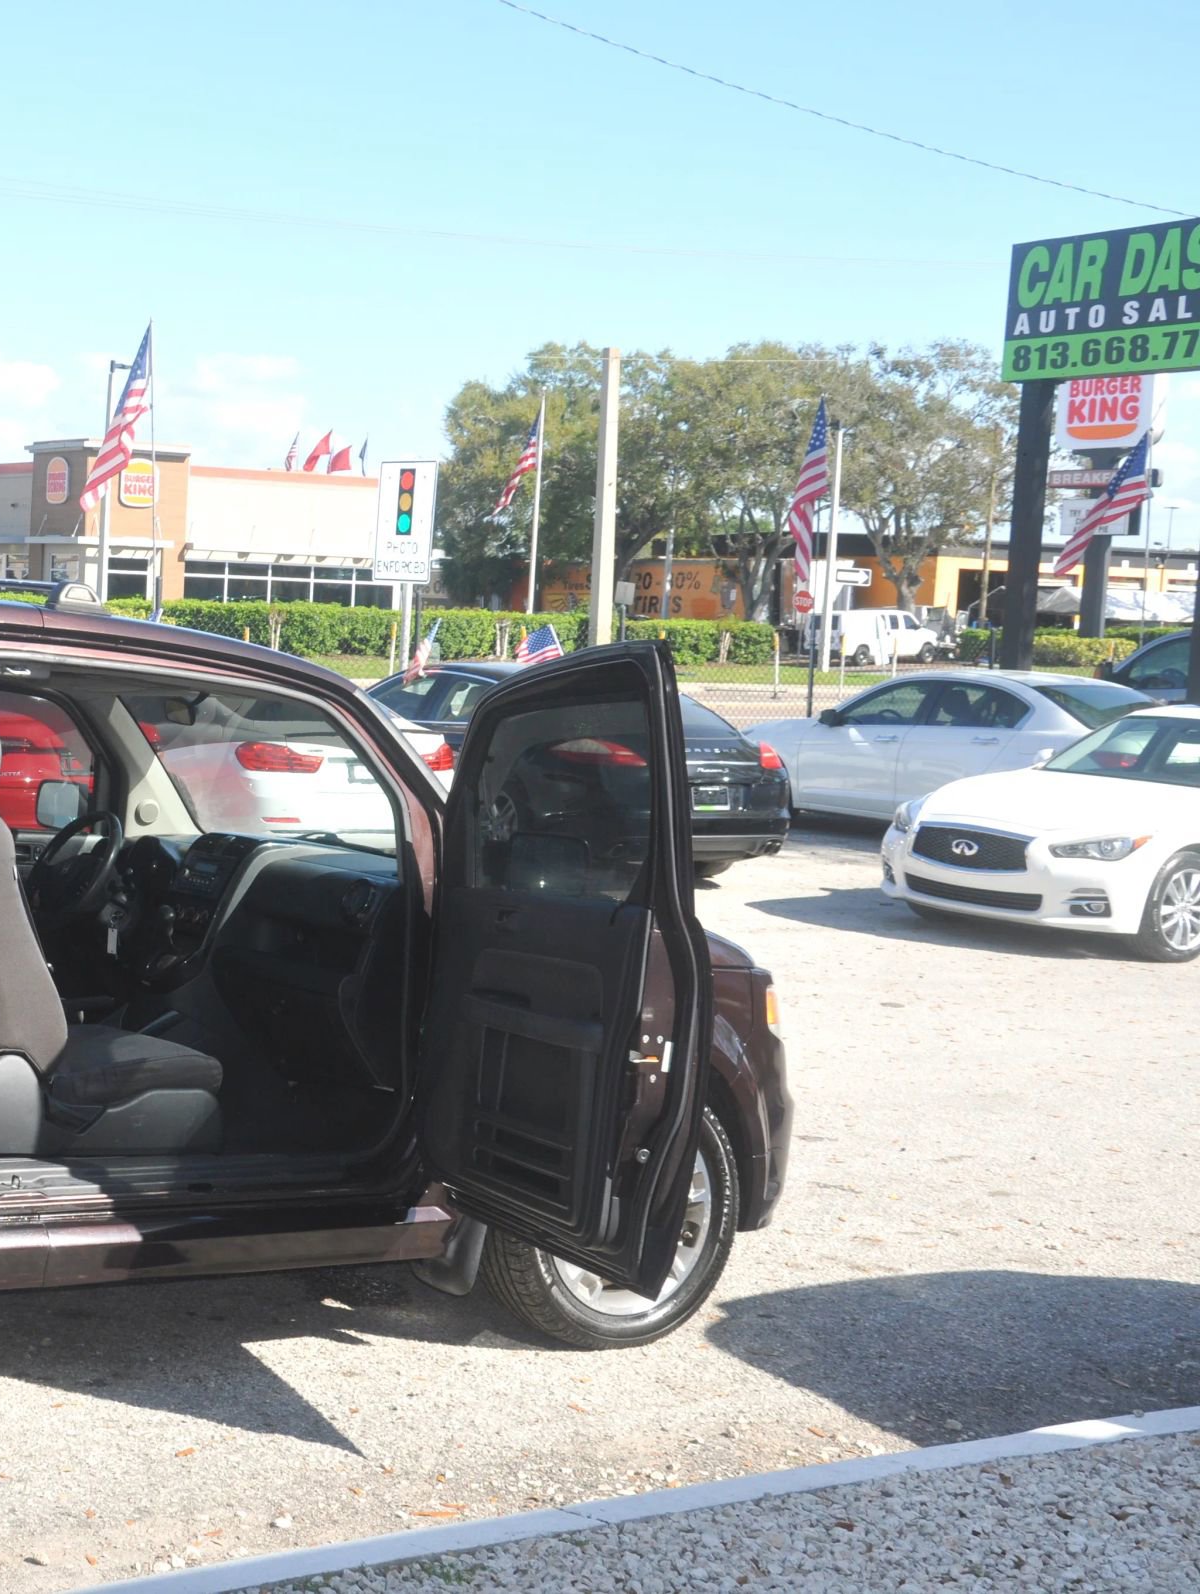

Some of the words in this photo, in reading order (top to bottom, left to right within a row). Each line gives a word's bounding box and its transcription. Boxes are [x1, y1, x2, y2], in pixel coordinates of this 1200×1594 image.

[1017, 239, 1108, 309] CAR
[1013, 304, 1106, 336] AUTO
[1121, 295, 1193, 326] SAL
[1011, 329, 1200, 373] 813.668.77
[1070, 376, 1142, 398] BURGER
[1066, 395, 1140, 425] KING
[1052, 471, 1111, 485] BREAKF
[384, 541, 418, 554] PHOTO
[376, 560, 426, 574] ENFORCED
[634, 594, 682, 615] TIRS
[795, 597, 813, 606] STOP
